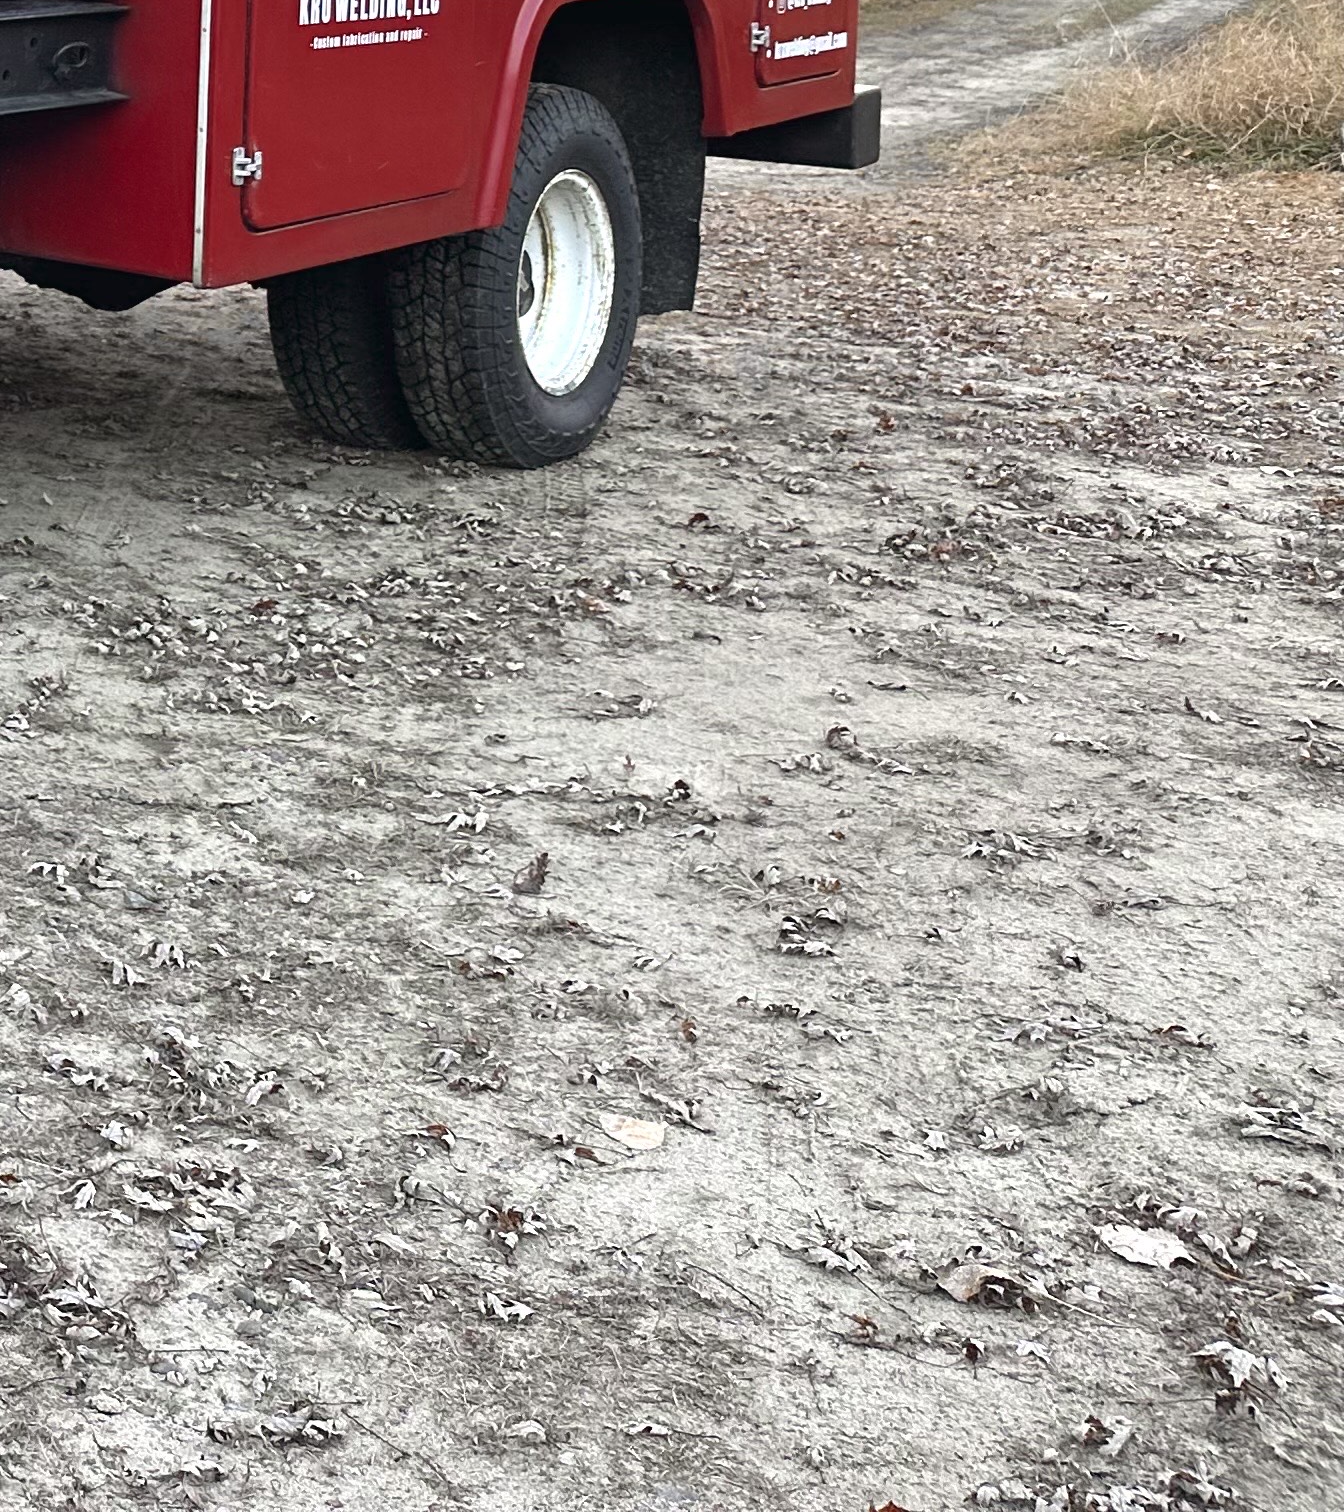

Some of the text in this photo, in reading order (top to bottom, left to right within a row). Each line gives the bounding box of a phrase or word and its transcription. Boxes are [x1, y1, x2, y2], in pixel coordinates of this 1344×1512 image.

[342, 31, 385, 47] fabrication
[385, 29, 399, 43] and
[400, 26, 423, 42] repair
